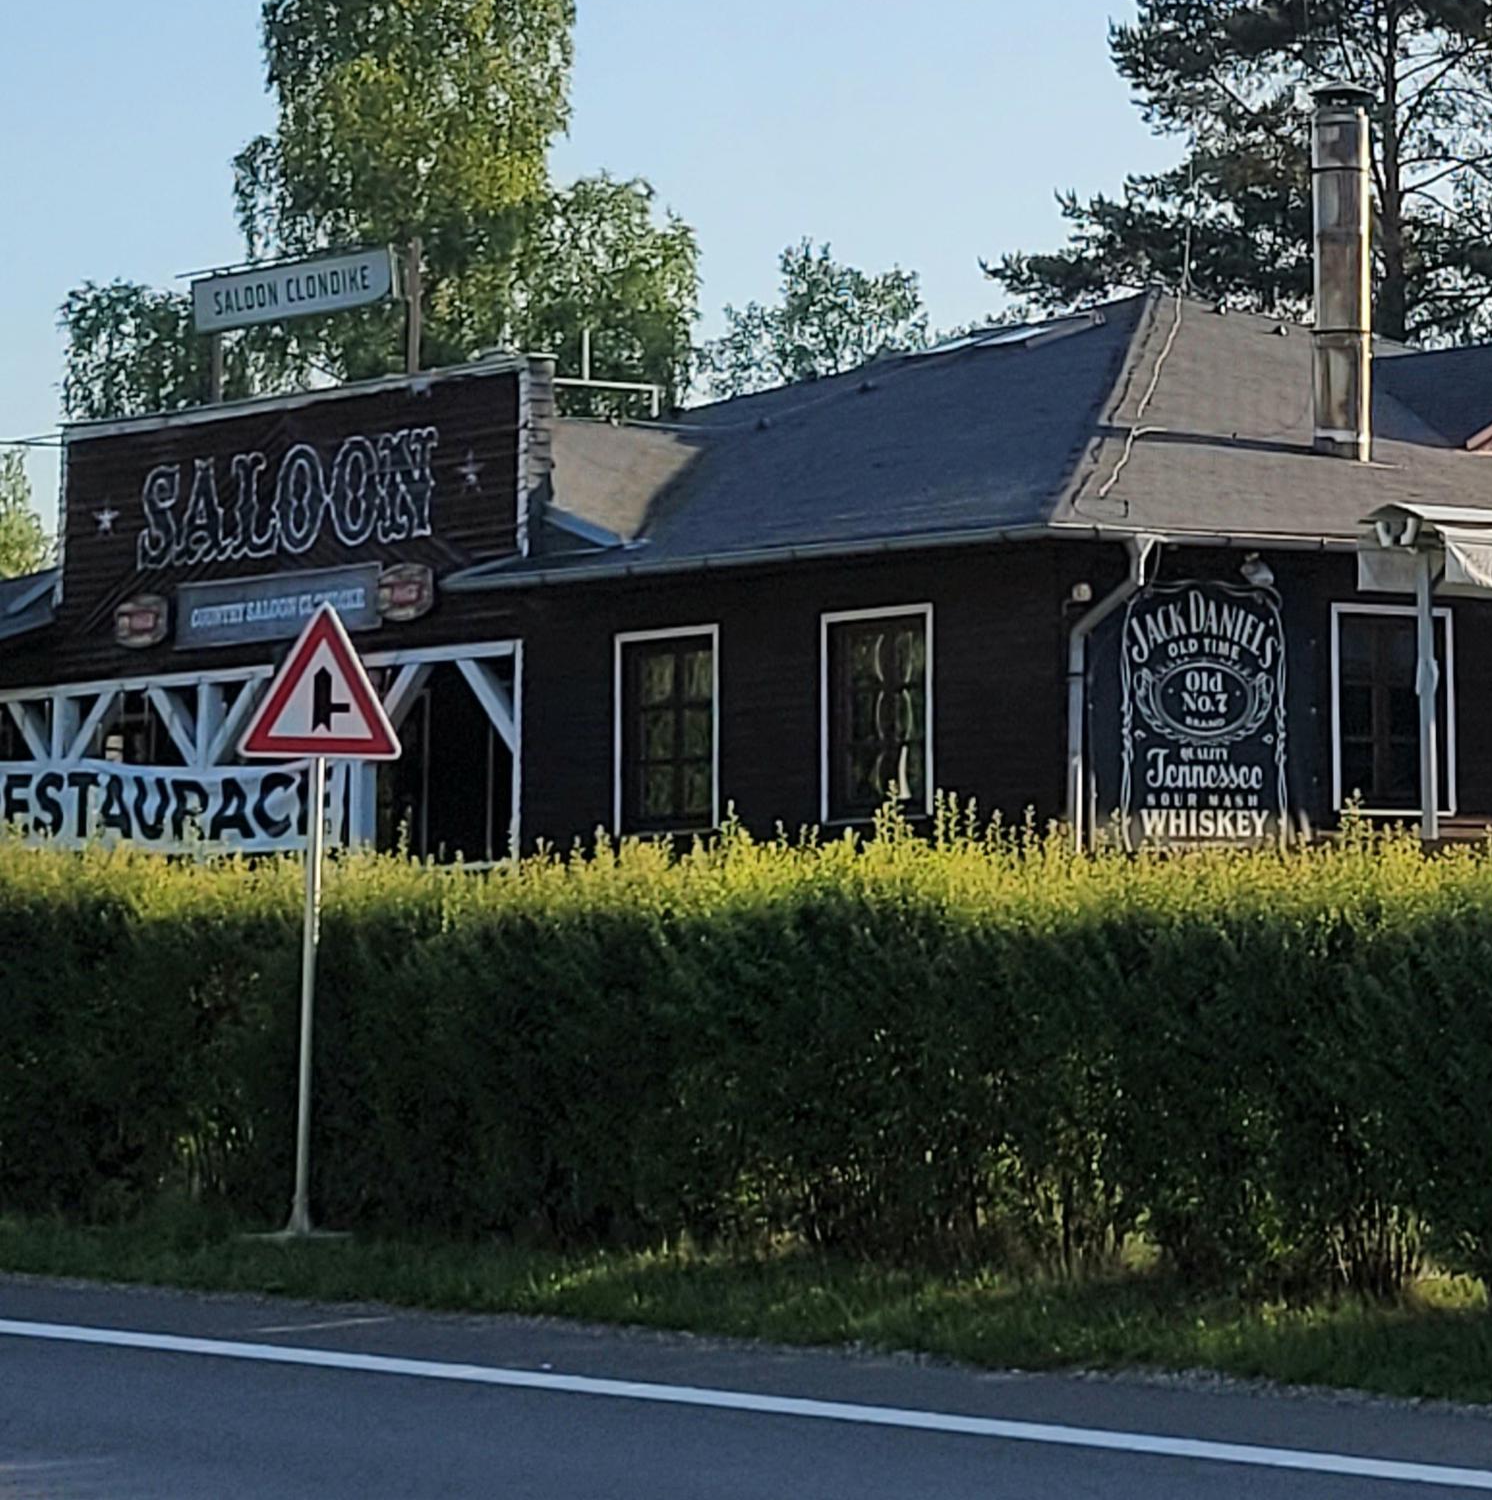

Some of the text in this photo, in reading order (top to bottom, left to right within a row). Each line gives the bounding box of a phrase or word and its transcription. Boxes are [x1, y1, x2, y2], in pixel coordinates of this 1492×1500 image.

[214, 265, 371, 316] SALOON CLONDIKE
[136, 426, 439, 571] SALOON
[246, 595, 298, 621] SALOON
[1131, 590, 1278, 669] JACK DANIEL'S
[1168, 638, 1241, 660] OLD TIME
[1185, 670, 1223, 692] Old
[1146, 748, 1264, 790] Tennessee
[1147, 792, 1259, 808] SOUR MASH
[1140, 809, 1269, 838] WHISKEY
